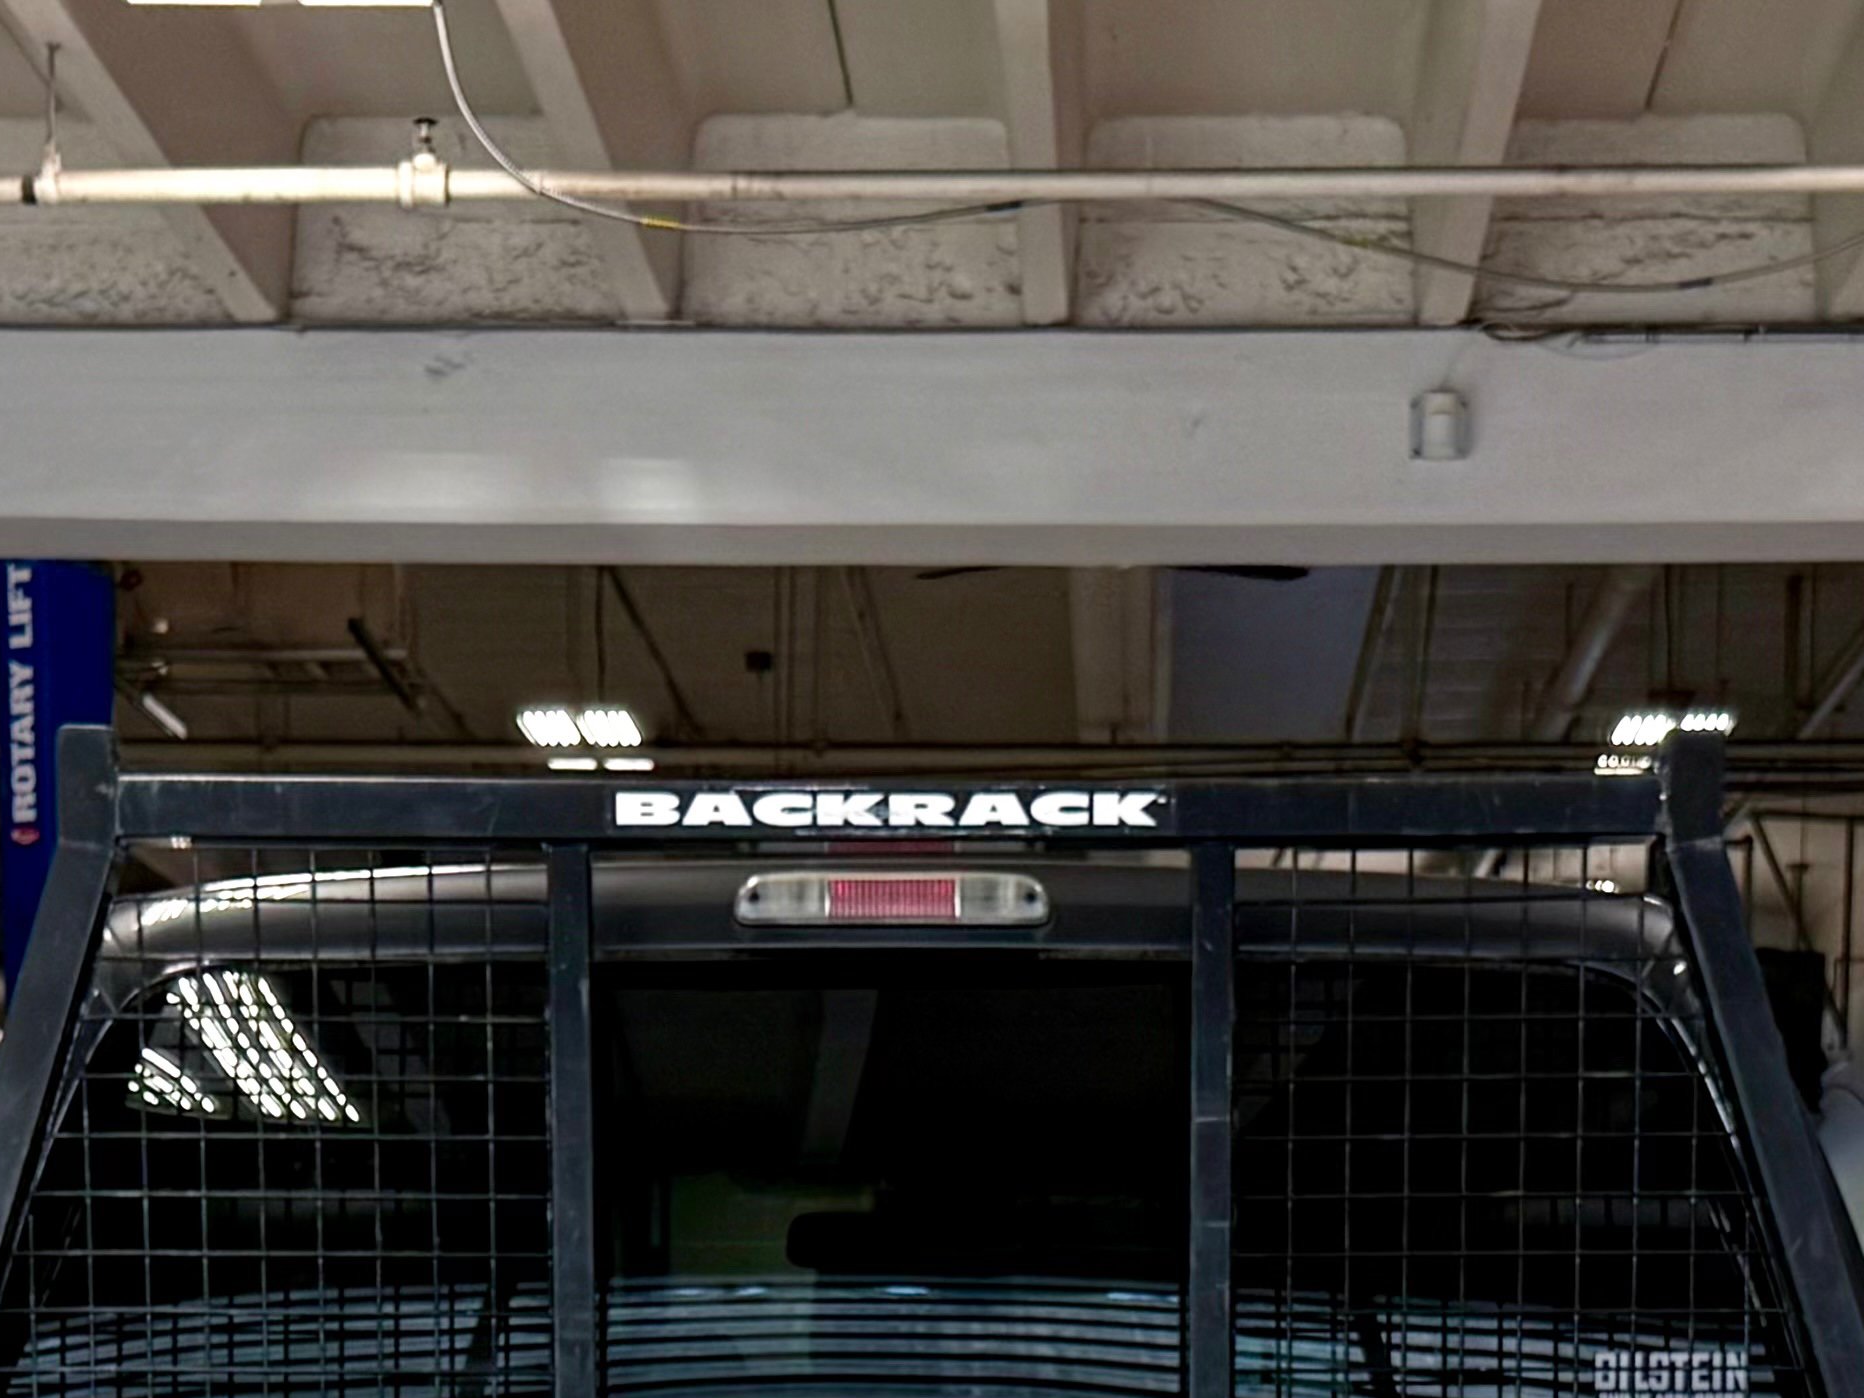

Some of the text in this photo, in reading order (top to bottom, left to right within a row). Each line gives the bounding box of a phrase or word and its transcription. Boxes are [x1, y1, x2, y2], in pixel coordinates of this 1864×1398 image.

[8, 562, 37, 823] ROTARY LIFT
[615, 791, 1158, 827] BACKRACK
[1594, 1351, 1748, 1391] BILSTEIN
